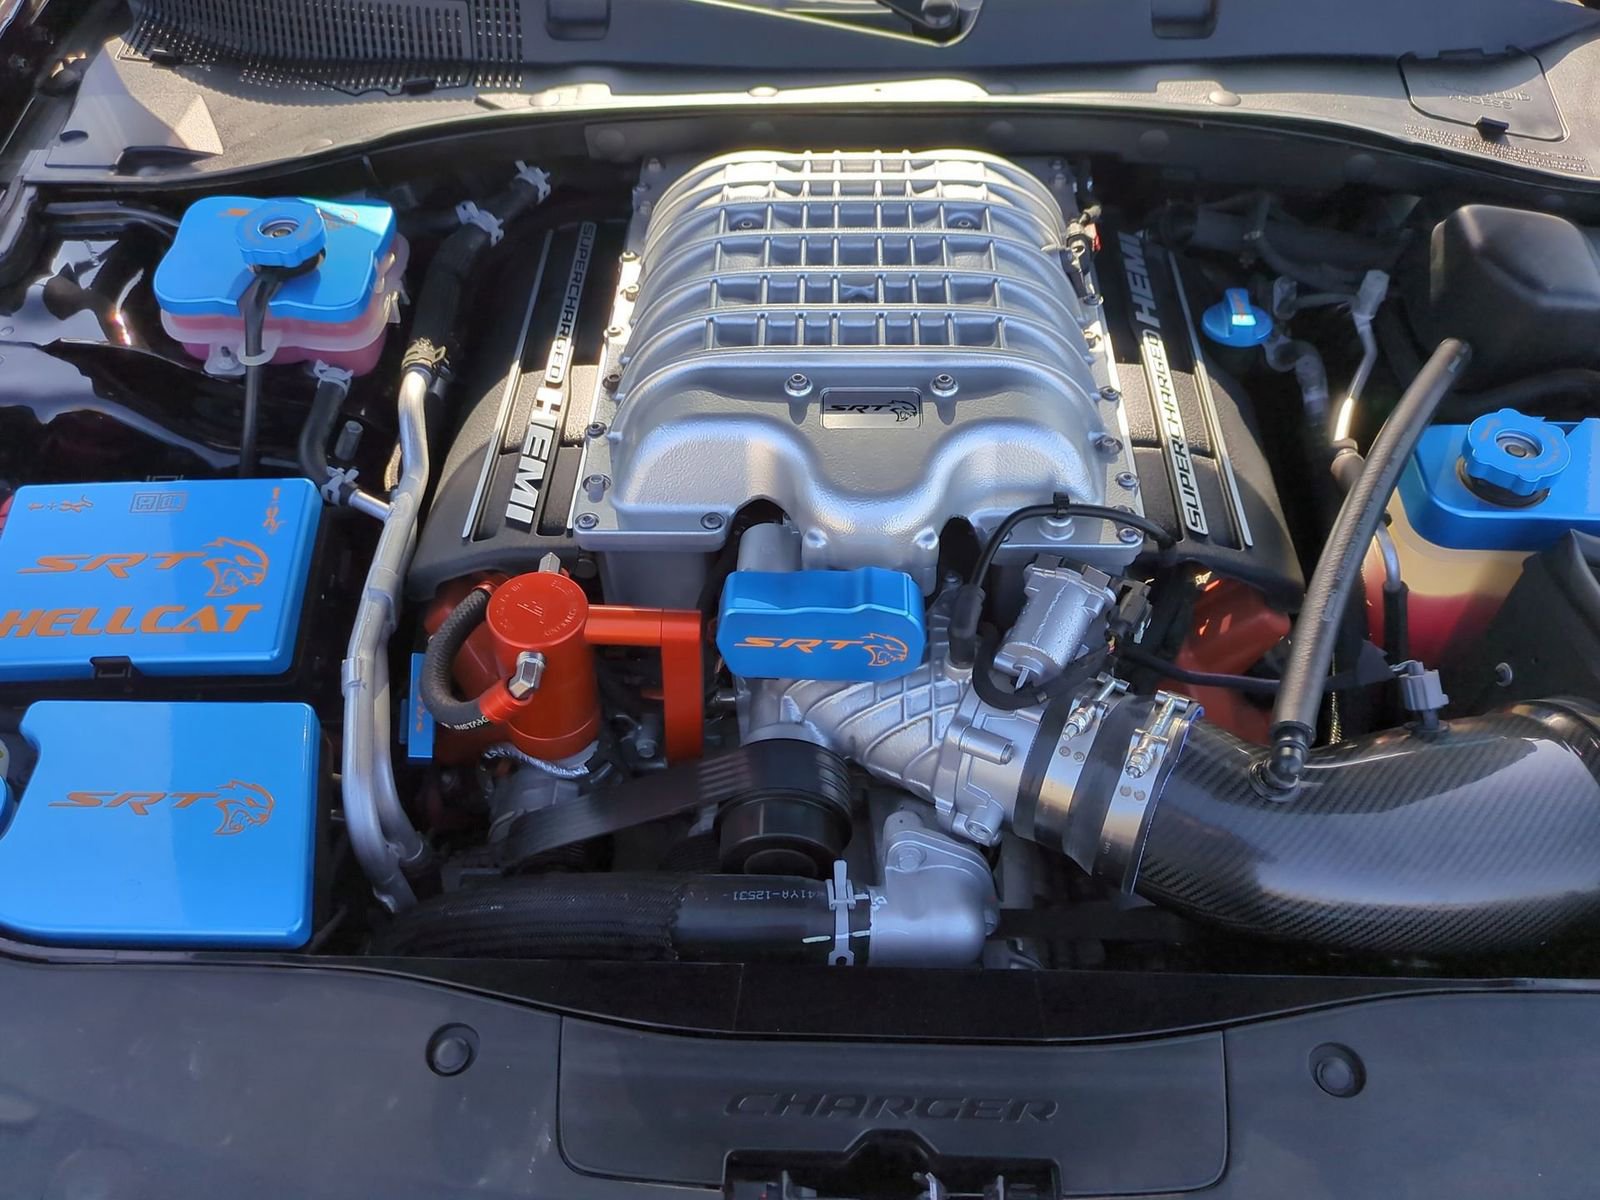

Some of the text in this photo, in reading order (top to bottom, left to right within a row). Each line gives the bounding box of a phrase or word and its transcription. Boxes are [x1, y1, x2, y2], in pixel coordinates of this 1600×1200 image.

[1117, 229, 1161, 328] HEMI
[547, 222, 596, 381] SUPERCHARGED
[826, 404, 891, 414] SRT
[1145, 330, 1206, 531] SUPERCHARGED
[505, 387, 563, 524] HEMI
[17, 552, 207, 578] SRT
[0, 604, 262, 638] HELLCAT
[734, 637, 864, 653] SRT
[48, 791, 221, 815] SRT
[723, 1093, 1058, 1123] CHARGER
